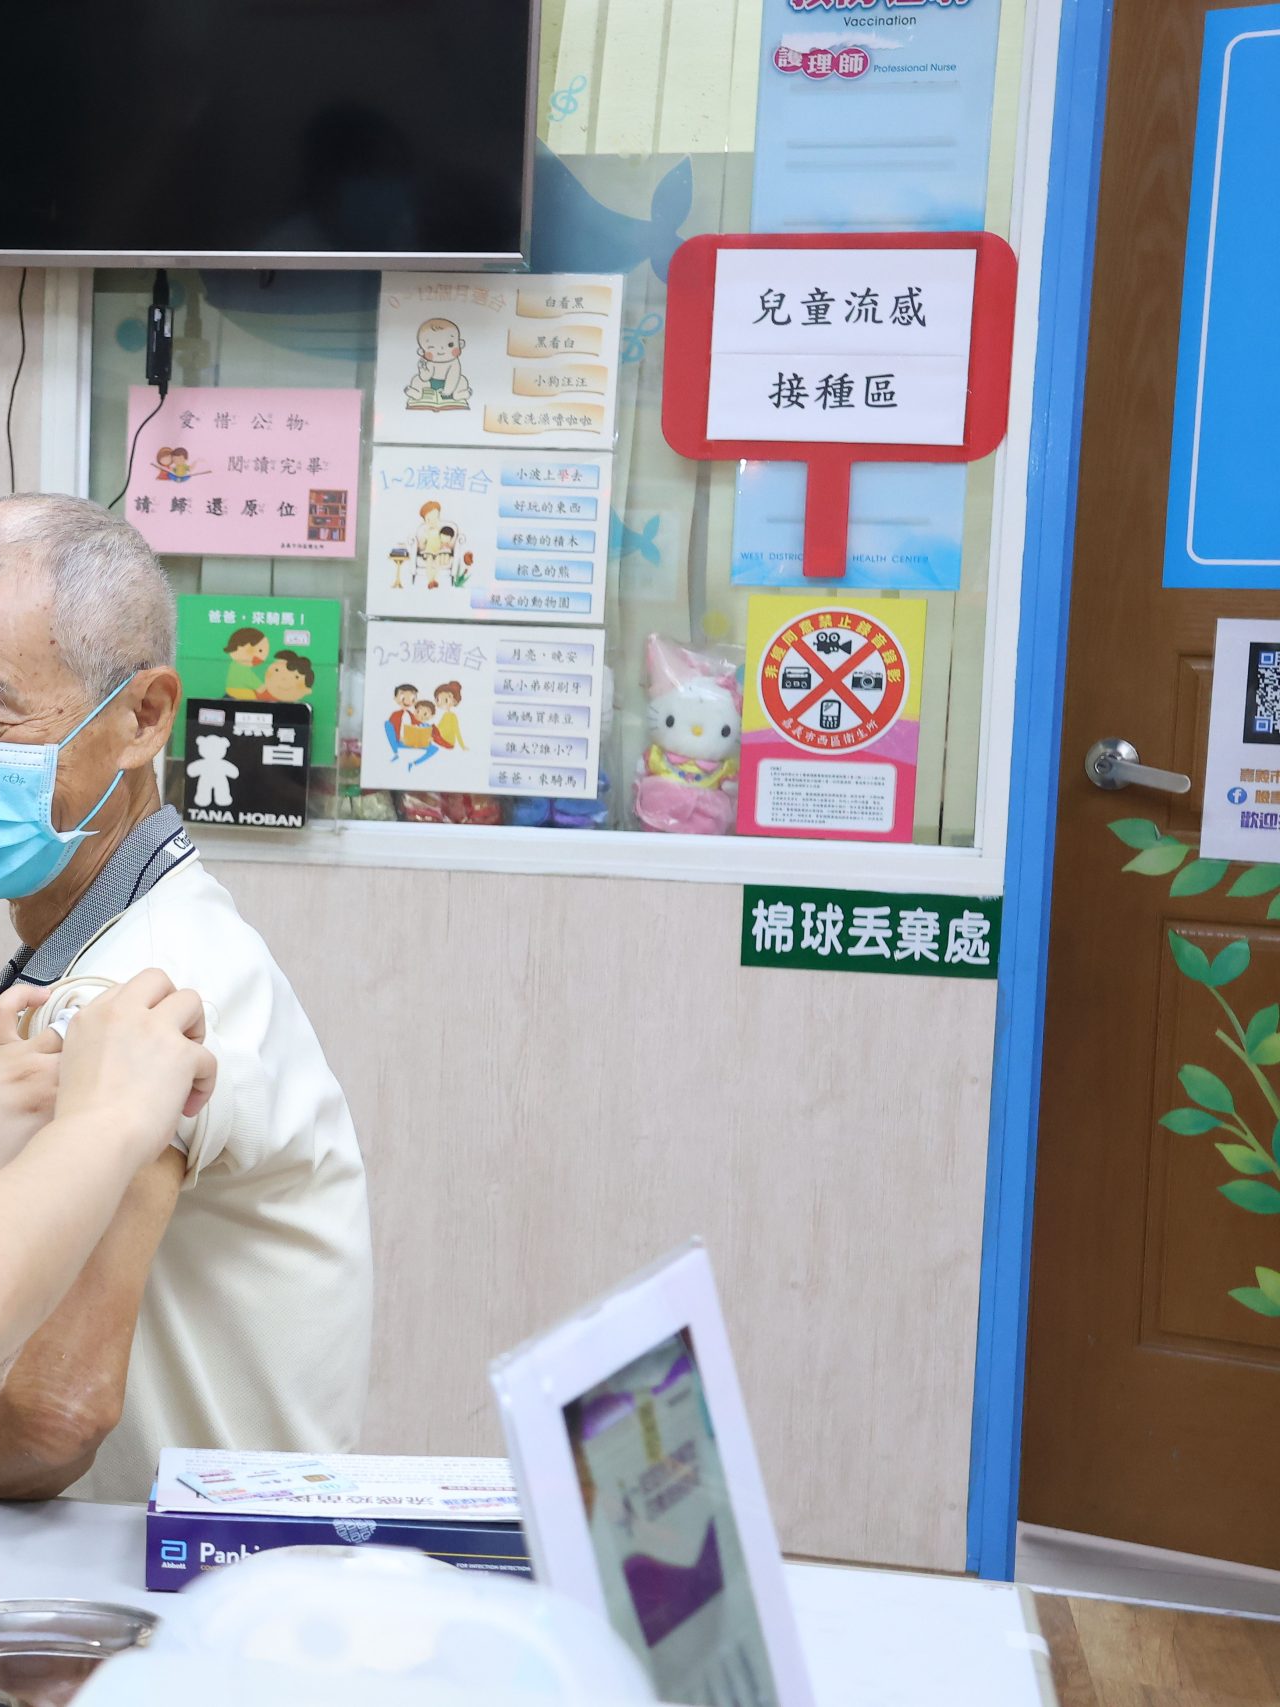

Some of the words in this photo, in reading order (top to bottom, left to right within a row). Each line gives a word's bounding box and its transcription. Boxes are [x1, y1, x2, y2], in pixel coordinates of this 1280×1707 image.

[844, 16, 917, 27] Vaccination
[778, 48, 865, 75] 護理師
[873, 65, 928, 73] Professional
[930, 63, 957, 72] Nurse
[545, 296, 585, 310] 白看黑
[753, 287, 926, 327] 兒童流感
[535, 336, 575, 350] 黑看白
[768, 372, 898, 410] 接種區
[741, 552, 764, 560] WEST
[770, 552, 803, 561] DISTRIC
[188, 808, 234, 823] TANA
[239, 811, 302, 827] HOBAN
[1240, 811, 1280, 830] 歡迎
[752, 899, 990, 965] 棉球丟棄處
[200, 1542, 260, 1564] Panb
